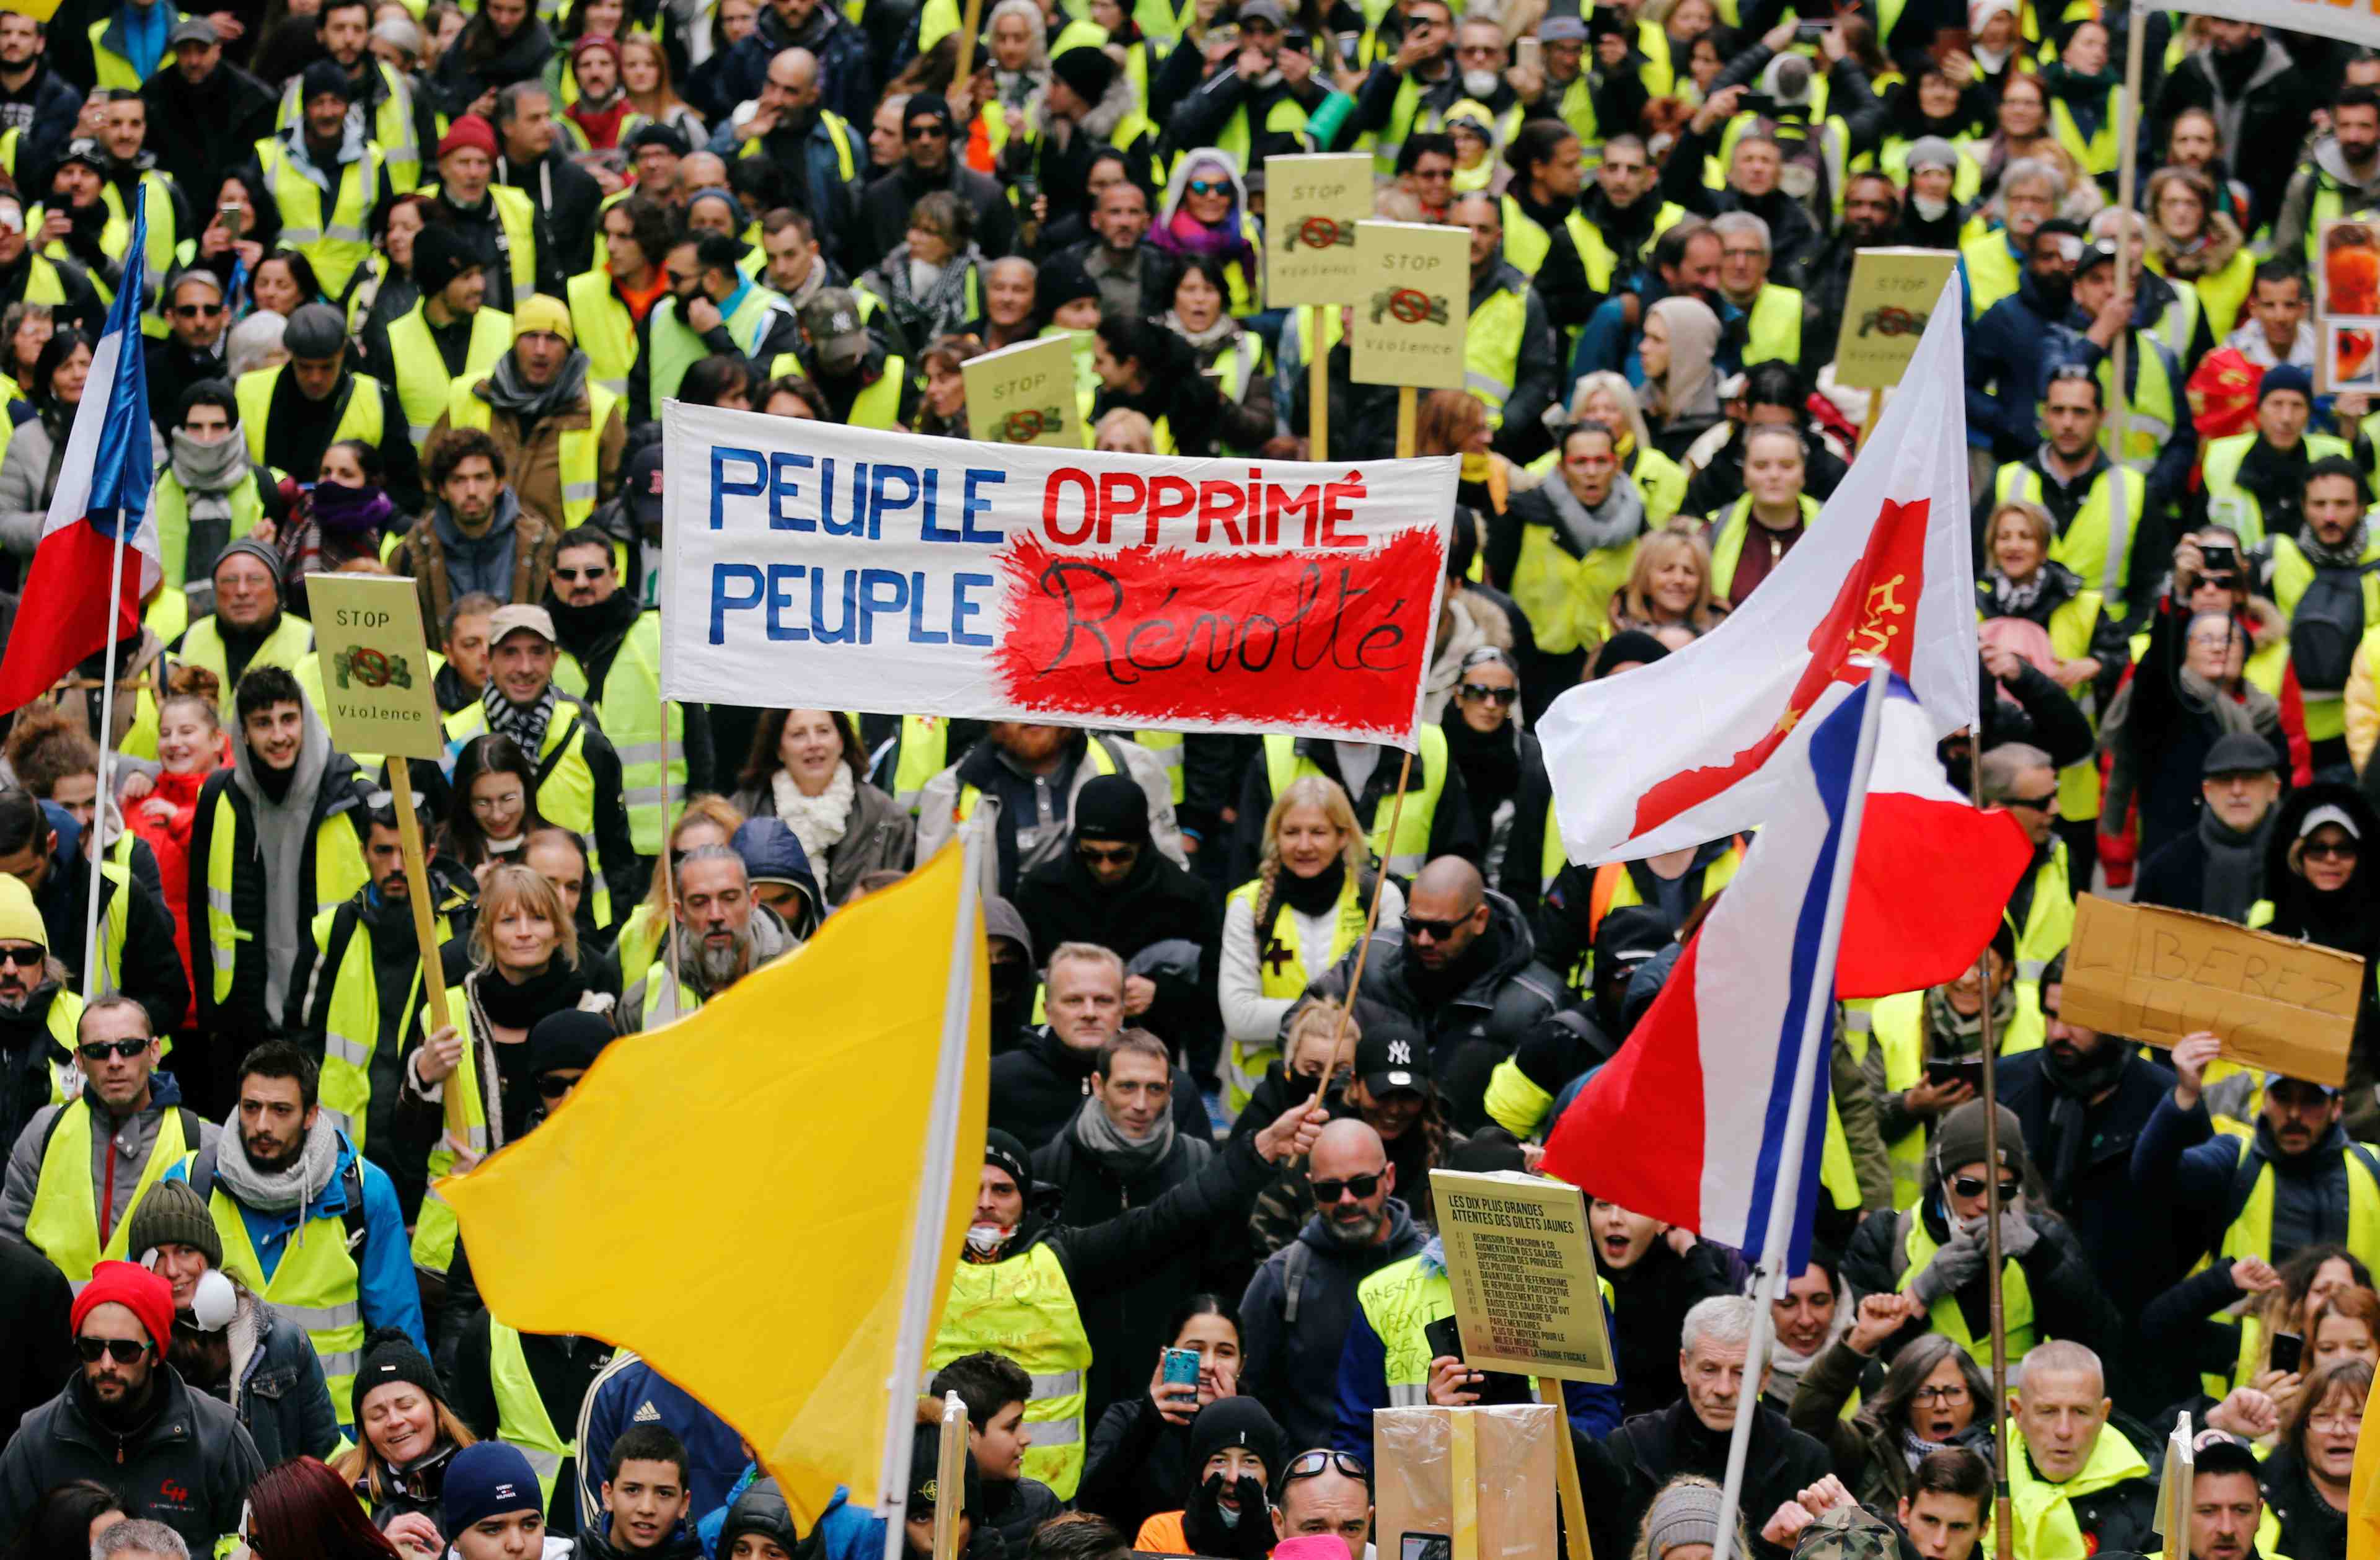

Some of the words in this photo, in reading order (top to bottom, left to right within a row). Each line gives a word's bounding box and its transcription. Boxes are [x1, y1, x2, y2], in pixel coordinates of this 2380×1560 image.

[1292, 185, 1346, 200] STOP
[1382, 255, 1440, 271] STOP
[993, 374, 1046, 399] STOP
[710, 446, 1005, 544] PEUPLE
[337, 610, 389, 628] STOP
[708, 563, 994, 646] PEUPLE
[1034, 558, 1411, 685] Révolté
[338, 705, 422, 721] Violence
[1388, 1040, 1411, 1064] NY
[1448, 1195, 1464, 1208] LES
[1467, 1197, 1479, 1210] DIX
[1483, 1199, 1502, 1212] PLUS
[1505, 1201, 1544, 1217] GRANDES
[1452, 1210, 1493, 1225] ATTENTES
[1496, 1214, 1511, 1227] DES
[1514, 1216, 1541, 1230] GILETS
[1543, 1220, 1574, 1234] JAUNES
[1507, 1236, 1514, 1245] DE
[1515, 1238, 1540, 1247] MACRON
[1475, 1243, 1520, 1254] AUGMENTATION
[1522, 1247, 1532, 1256] DES
[1534, 1249, 1562, 1259] SALAIRES
[1476, 1252, 1516, 1263] SUPPRESSION
[1518, 1256, 1528, 1266] DES
[1478, 1261, 1489, 1271] DES
[1491, 1263, 1525, 1274] POLITIQUES
[1480, 1271, 1514, 1281] DAVANTAGE
[1517, 1274, 1523, 1282] DE
[1527, 1285, 1570, 1297] PARTICIPATIVE
[1486, 1299, 1505, 1308] BAISSE
[1508, 1302, 1518, 1310] DES
[1520, 1302, 1548, 1313] SALAIRES
[1550, 1305, 1558, 1313] DU
[1559, 1307, 1570, 1315] GVT
[1488, 1308, 1508, 1318] BAISSE
[1510, 1310, 1518, 1318] DU
[1519, 1312, 1543, 1321] NOMBRE
[1546, 1314, 1552, 1322] DE
[1489, 1317, 1541, 1330] PARLEMENTAIRES
[1491, 1327, 1505, 1336] PLUS
[1506, 1329, 1514, 1337] DE
[1515, 1329, 1540, 1339] MOYENS
[1542, 1333, 1557, 1341] POUR
[1559, 1334, 1566, 1342] LE
[1494, 1336, 1512, 1346] MILIEU
[1495, 1346, 1530, 1357] COMBATTRE
[1532, 1349, 1539, 1357] LA
[1540, 1350, 1562, 1360] FRAUDE
[1564, 1352, 1587, 1362] FISCALE
